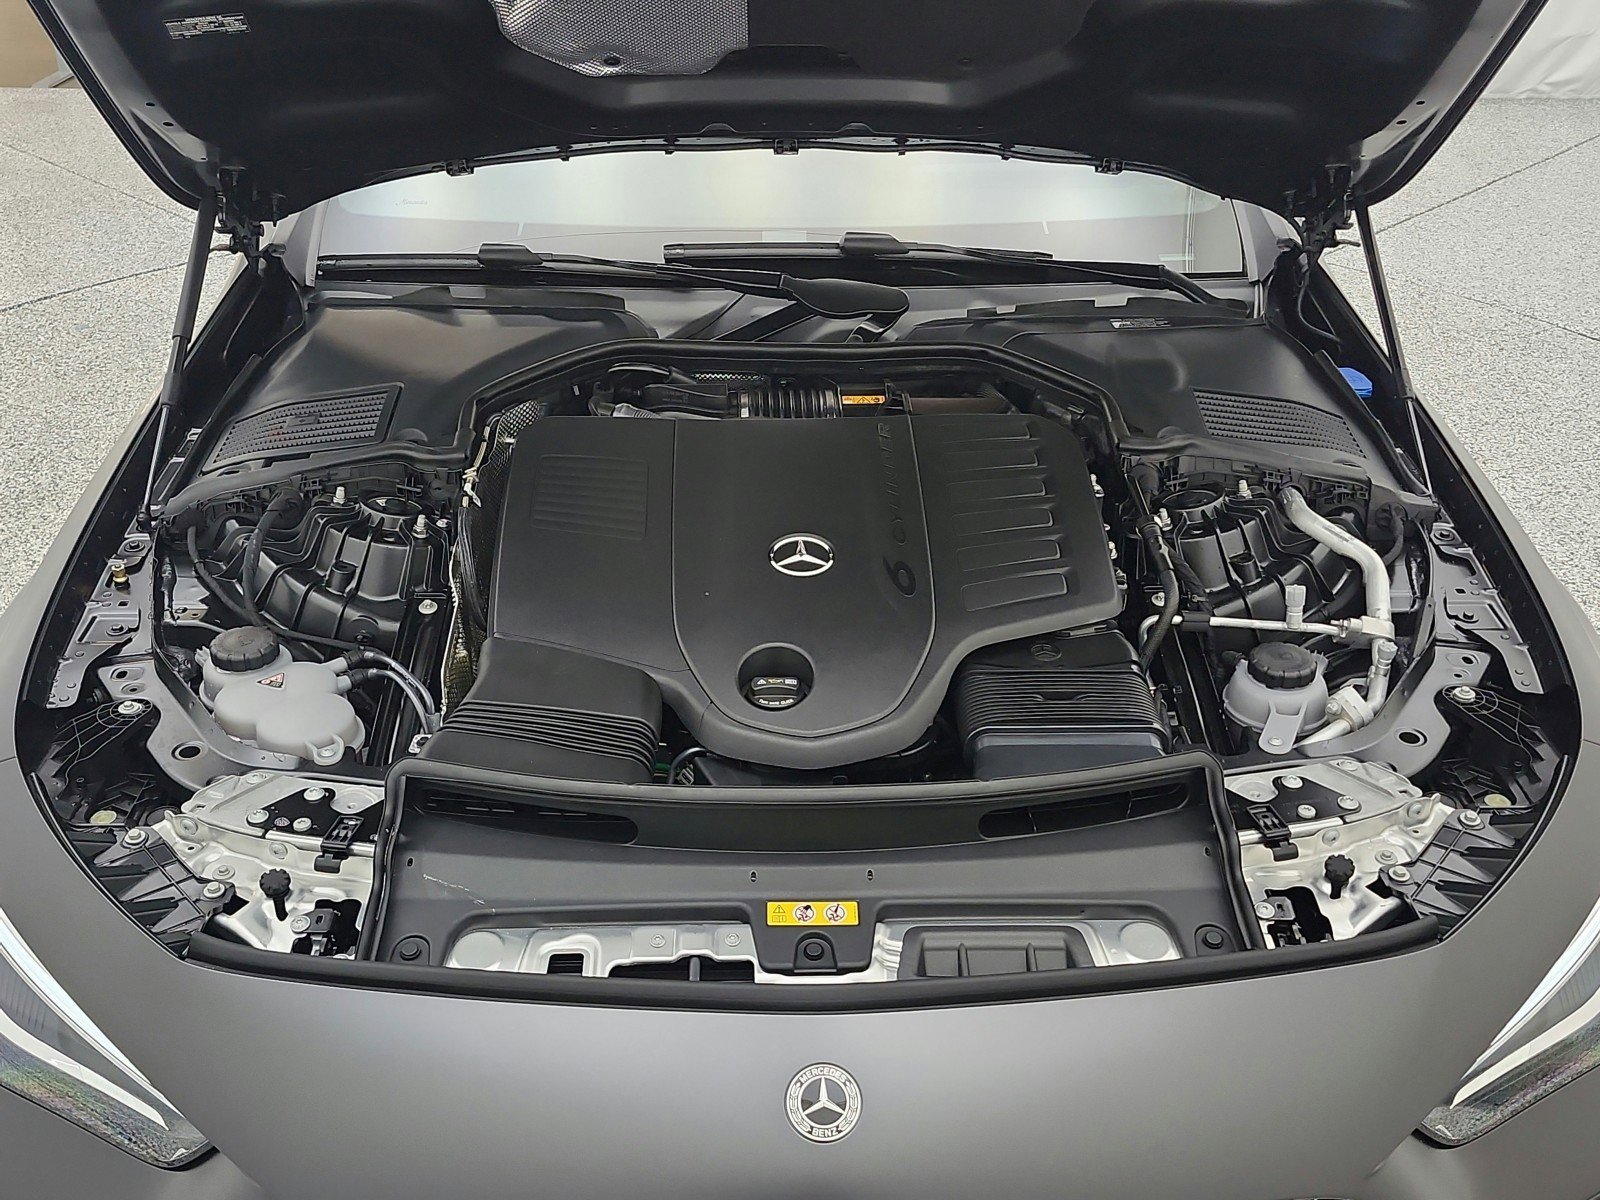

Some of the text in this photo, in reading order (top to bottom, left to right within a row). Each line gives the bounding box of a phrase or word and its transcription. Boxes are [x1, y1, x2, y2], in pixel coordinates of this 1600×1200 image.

[882, 556, 917, 598] 6
[799, 1067, 847, 1083] MERCEDES
[812, 1128, 838, 1137] BENZ
